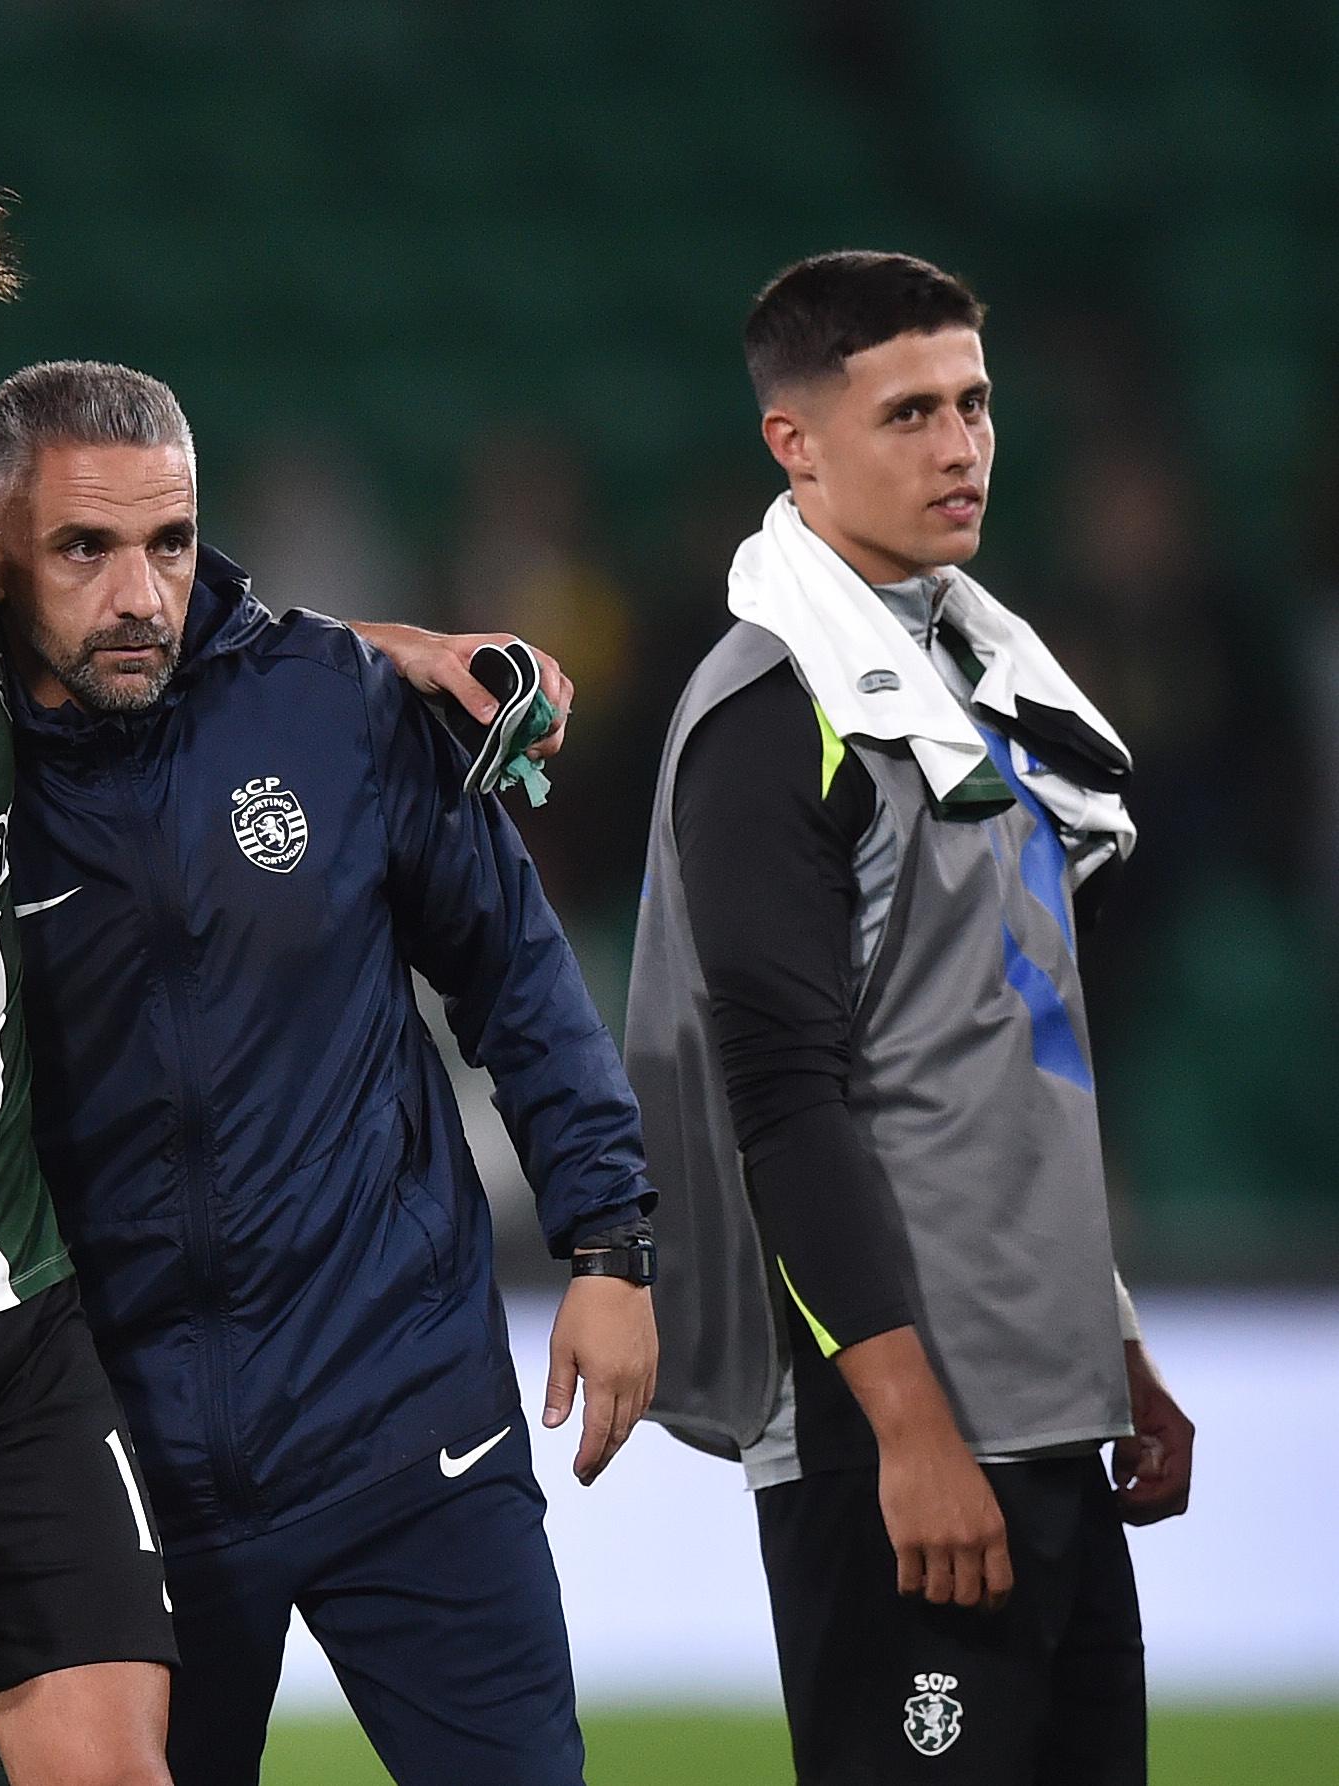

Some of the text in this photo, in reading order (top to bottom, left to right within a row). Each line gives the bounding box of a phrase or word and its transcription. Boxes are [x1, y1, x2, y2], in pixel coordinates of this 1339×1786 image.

[231, 777, 280, 806] SCP
[239, 797, 292, 828] SPORTING
[256, 841, 304, 865] PORTUGAL
[104, 1428, 164, 1557] 1
